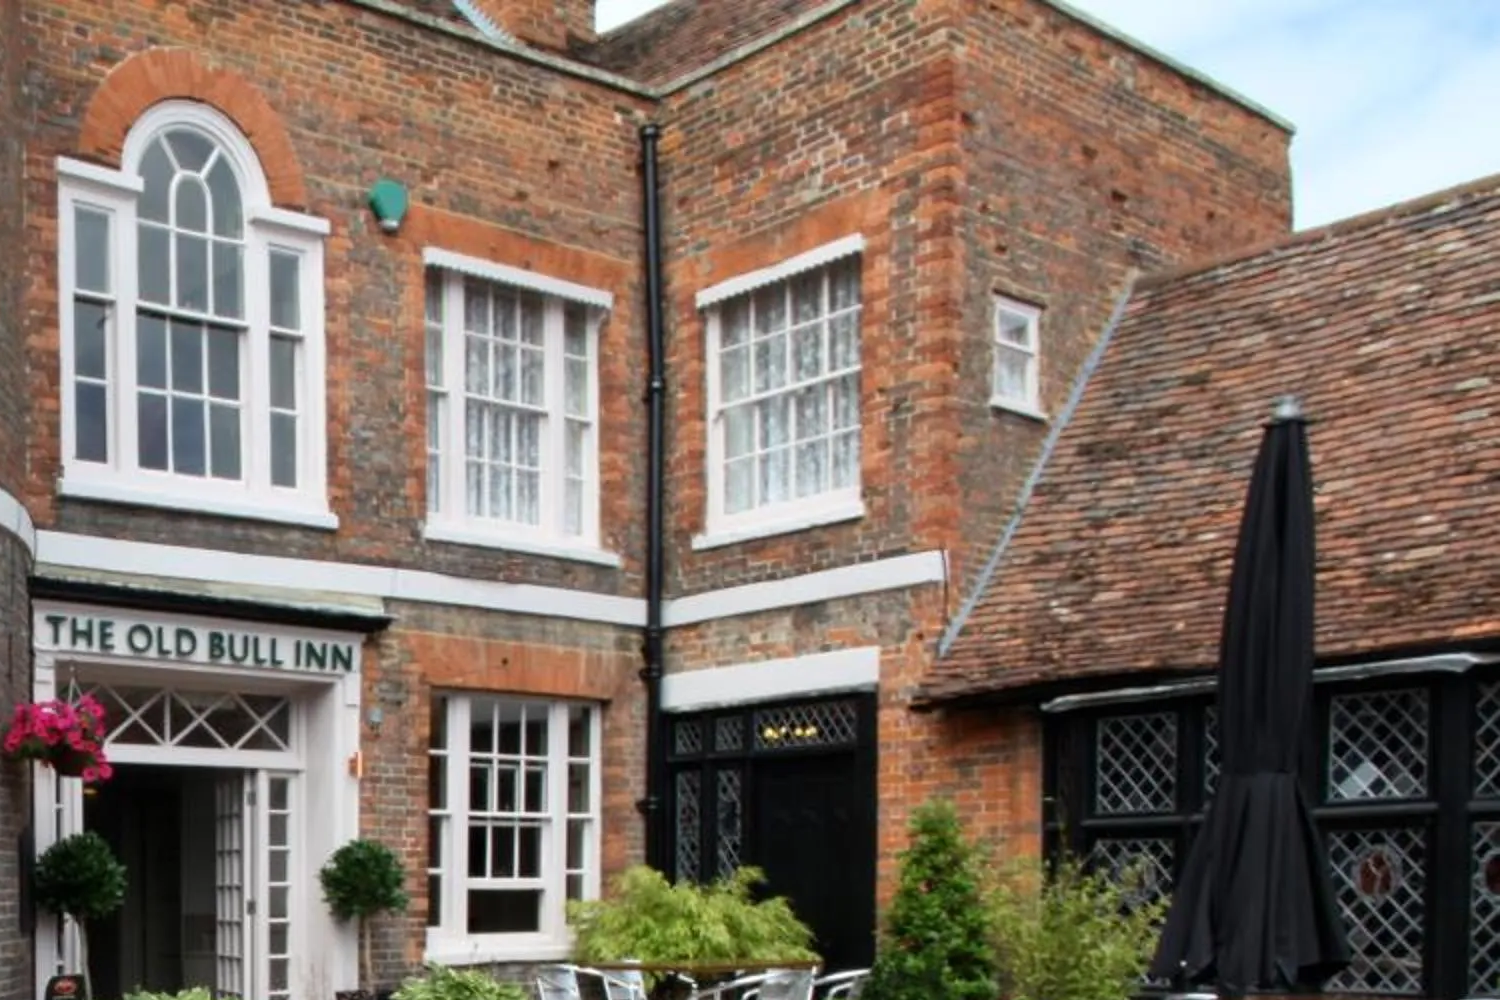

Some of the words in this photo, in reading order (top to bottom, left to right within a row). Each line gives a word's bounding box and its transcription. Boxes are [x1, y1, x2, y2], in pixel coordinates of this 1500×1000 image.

[45, 615, 115, 650] THE
[127, 624, 197, 657] OLD
[209, 631, 284, 667] BULL
[295, 639, 353, 671] INN
